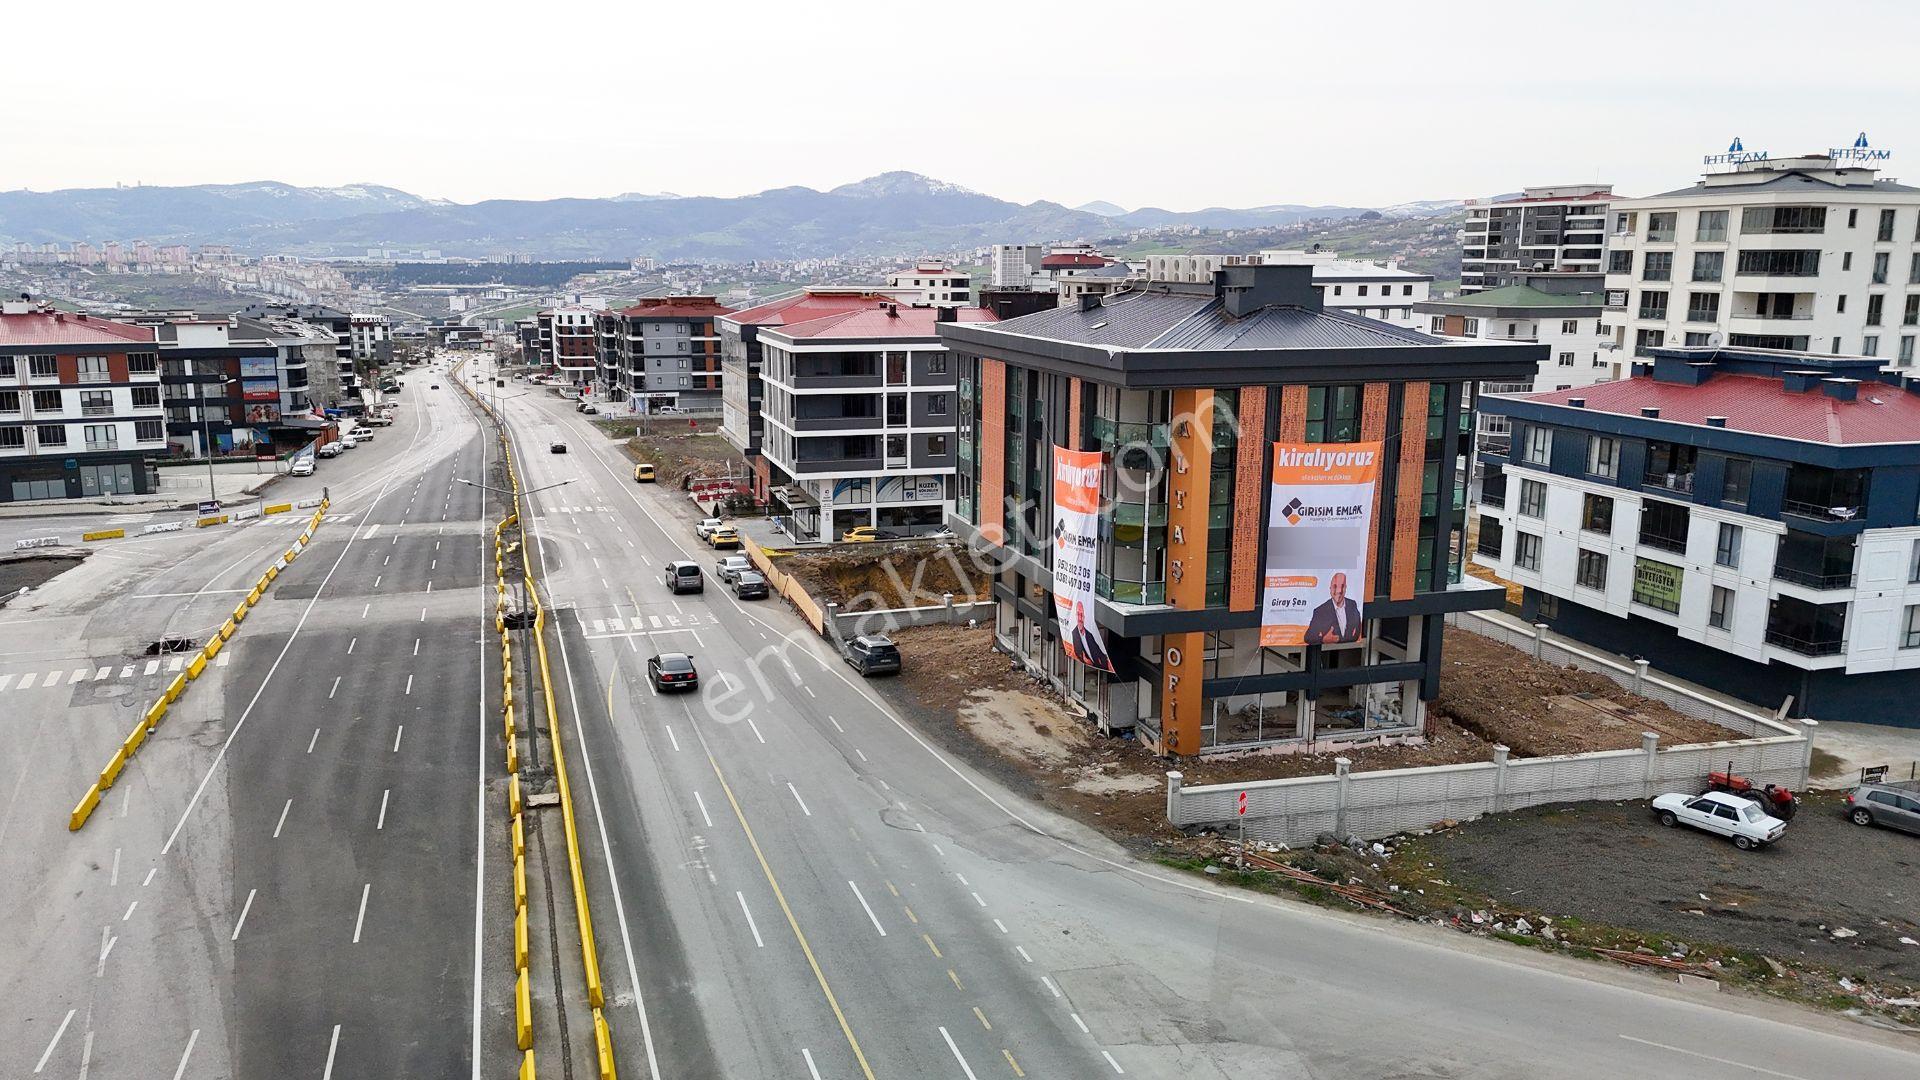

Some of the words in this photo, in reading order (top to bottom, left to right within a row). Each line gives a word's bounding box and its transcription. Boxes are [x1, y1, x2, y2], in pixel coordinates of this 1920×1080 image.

[1279, 447, 1375, 471] kiralıyoruz
[1271, 598, 1291, 608] Giray
[1292, 597, 1307, 607] Şen
